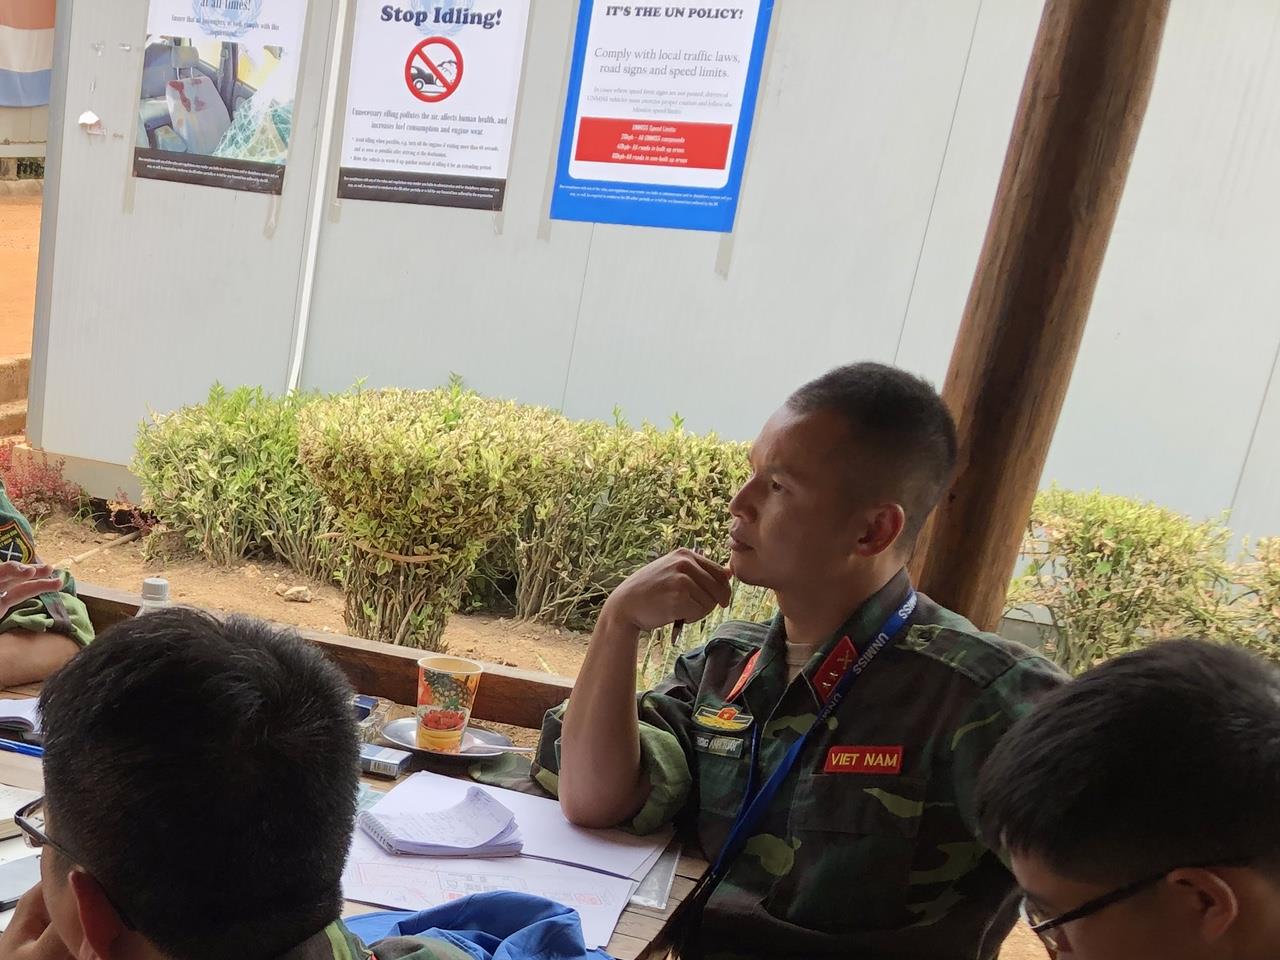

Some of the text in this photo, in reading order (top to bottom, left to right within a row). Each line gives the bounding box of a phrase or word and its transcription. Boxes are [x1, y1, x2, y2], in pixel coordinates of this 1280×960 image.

[380, 5, 502, 30] Stop Idling!
[606, 5, 744, 19] IT'S THE UN POLICY!
[594, 47, 741, 64] Comply with local traffic laws,
[599, 62, 729, 79] road signs and speed limits.
[852, 632, 889, 675] UNMISS
[831, 753, 898, 767] VIET NAM
